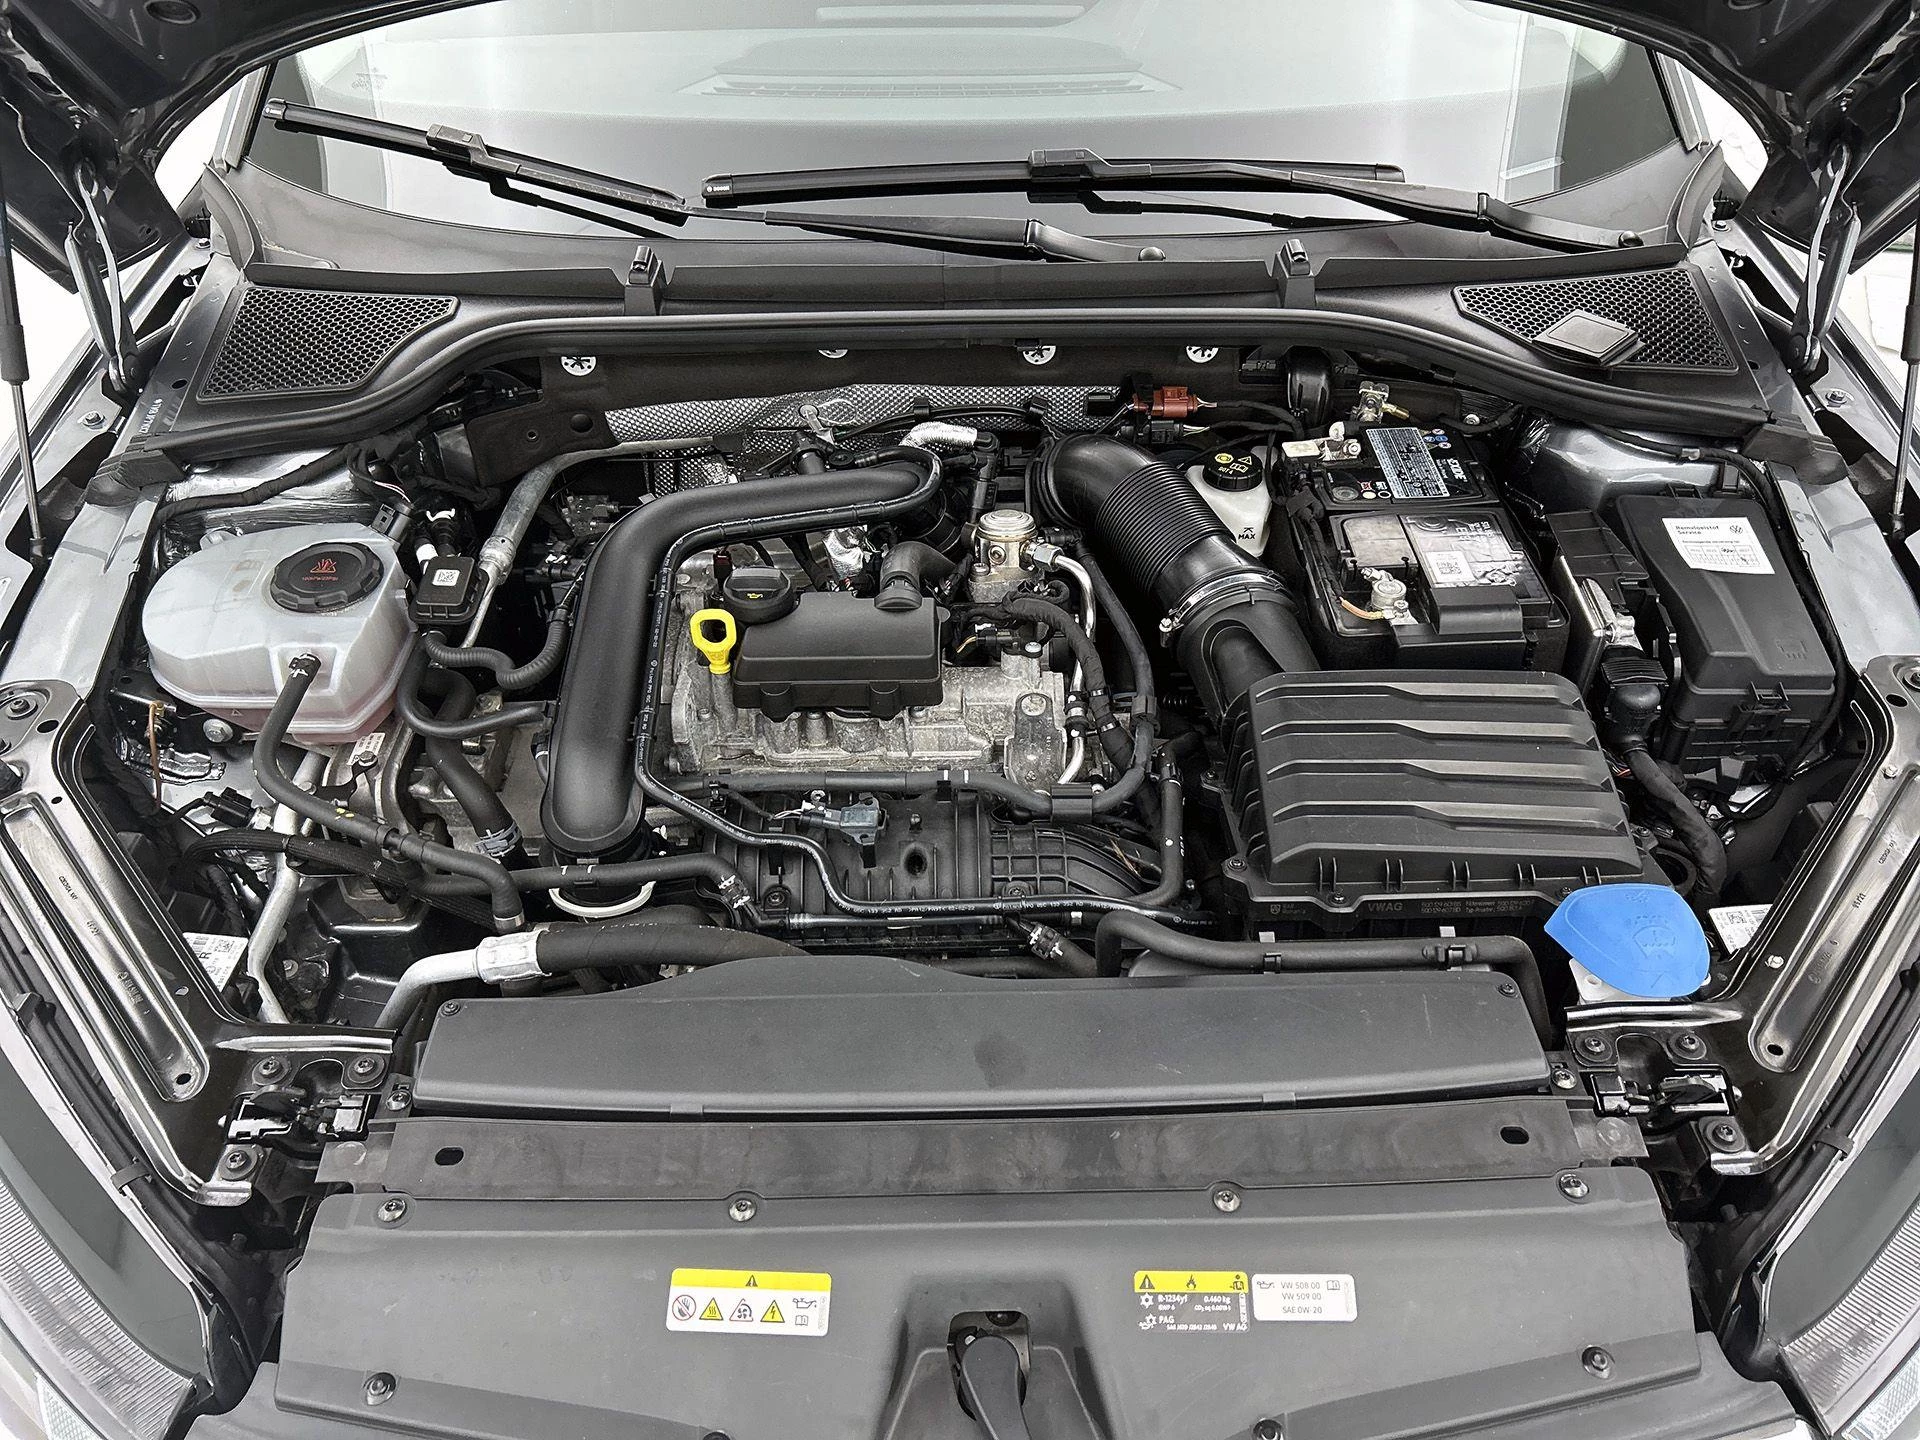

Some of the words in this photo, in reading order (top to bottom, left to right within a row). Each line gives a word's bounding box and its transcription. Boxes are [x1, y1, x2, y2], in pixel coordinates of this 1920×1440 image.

[1281, 1281, 1294, 1289] VW
[1296, 1281, 1310, 1289] 508
[1311, 1281, 1321, 1289] 00
[1157, 1294, 1188, 1305] R-1234yf
[1222, 1295, 1231, 1304] kg
[1282, 1292, 1295, 1300] VW
[1296, 1292, 1311, 1300] 509
[1312, 1292, 1322, 1300] 00
[1282, 1306, 1296, 1314] SAE
[1158, 1315, 1175, 1324] PAG
[1222, 1323, 1236, 1331] VW
[1236, 1323, 1248, 1331] AG
